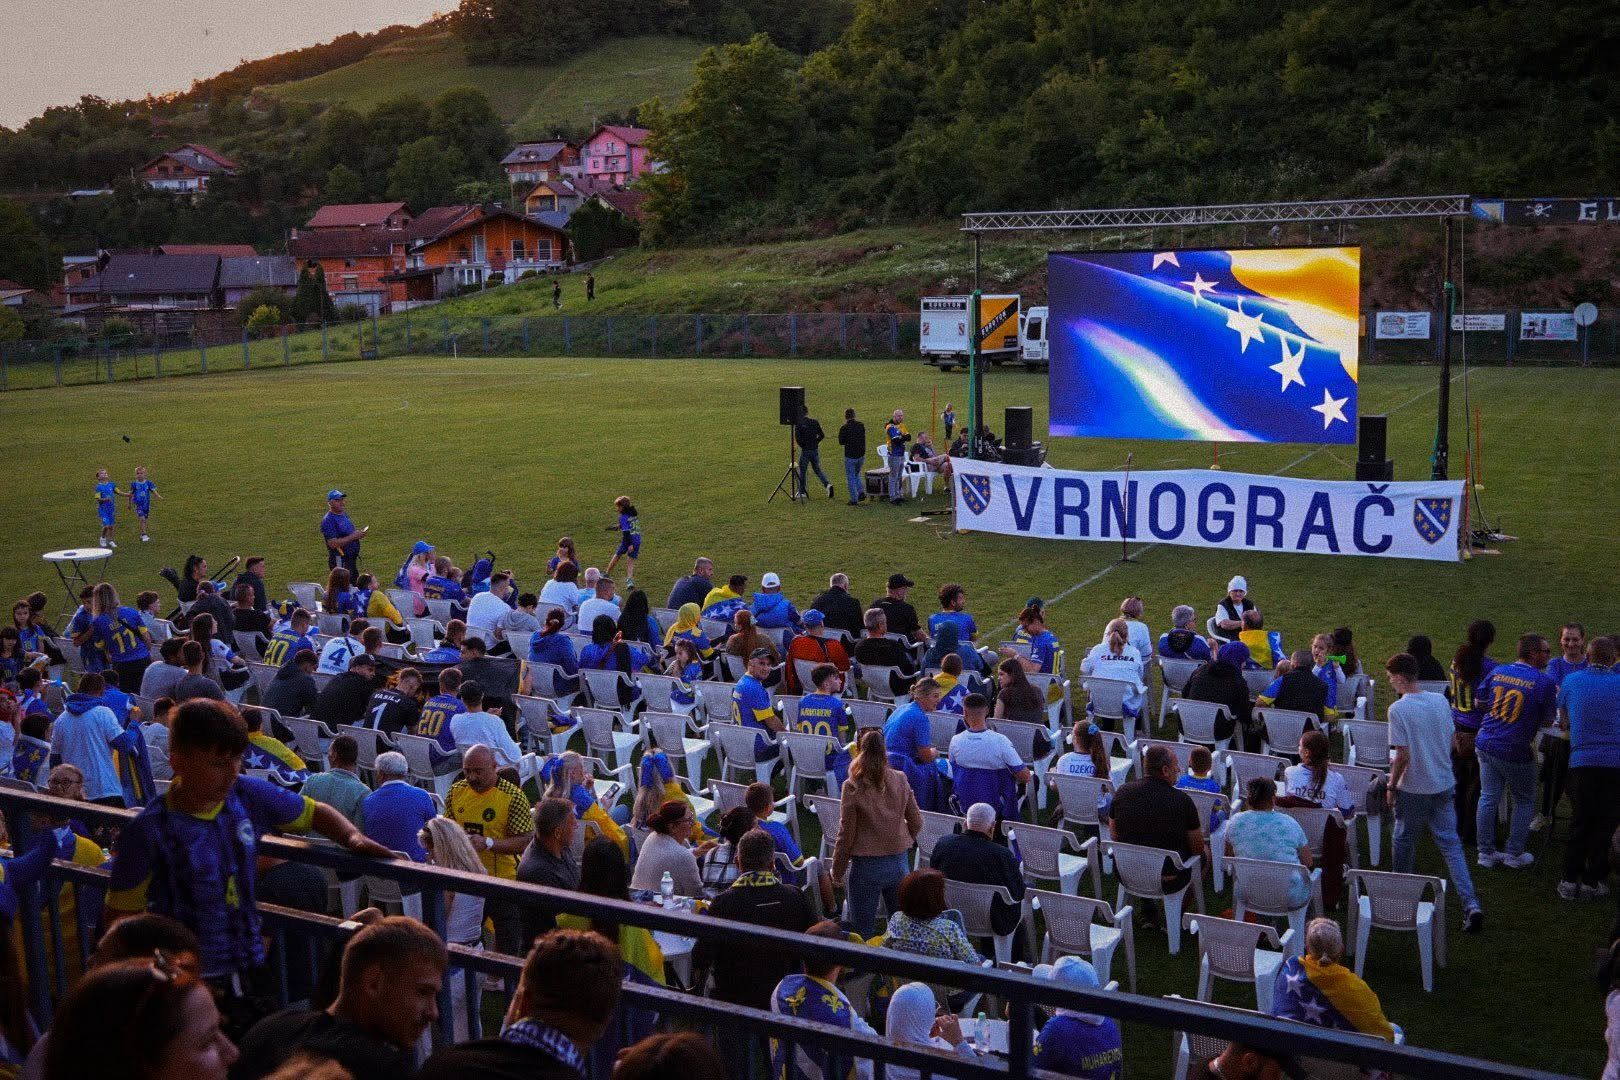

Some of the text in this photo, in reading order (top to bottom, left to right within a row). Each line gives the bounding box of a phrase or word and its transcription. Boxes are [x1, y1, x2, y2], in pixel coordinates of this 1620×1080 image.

[1002, 474, 1395, 554] VRNOGRAČ
[112, 628, 137, 654] 11
[264, 639, 290, 666] 20
[328, 648, 347, 667] 4
[374, 693, 401, 703] VASILJ
[1490, 685, 1524, 724] 10
[370, 703, 388, 730] 1
[417, 709, 446, 737] 20
